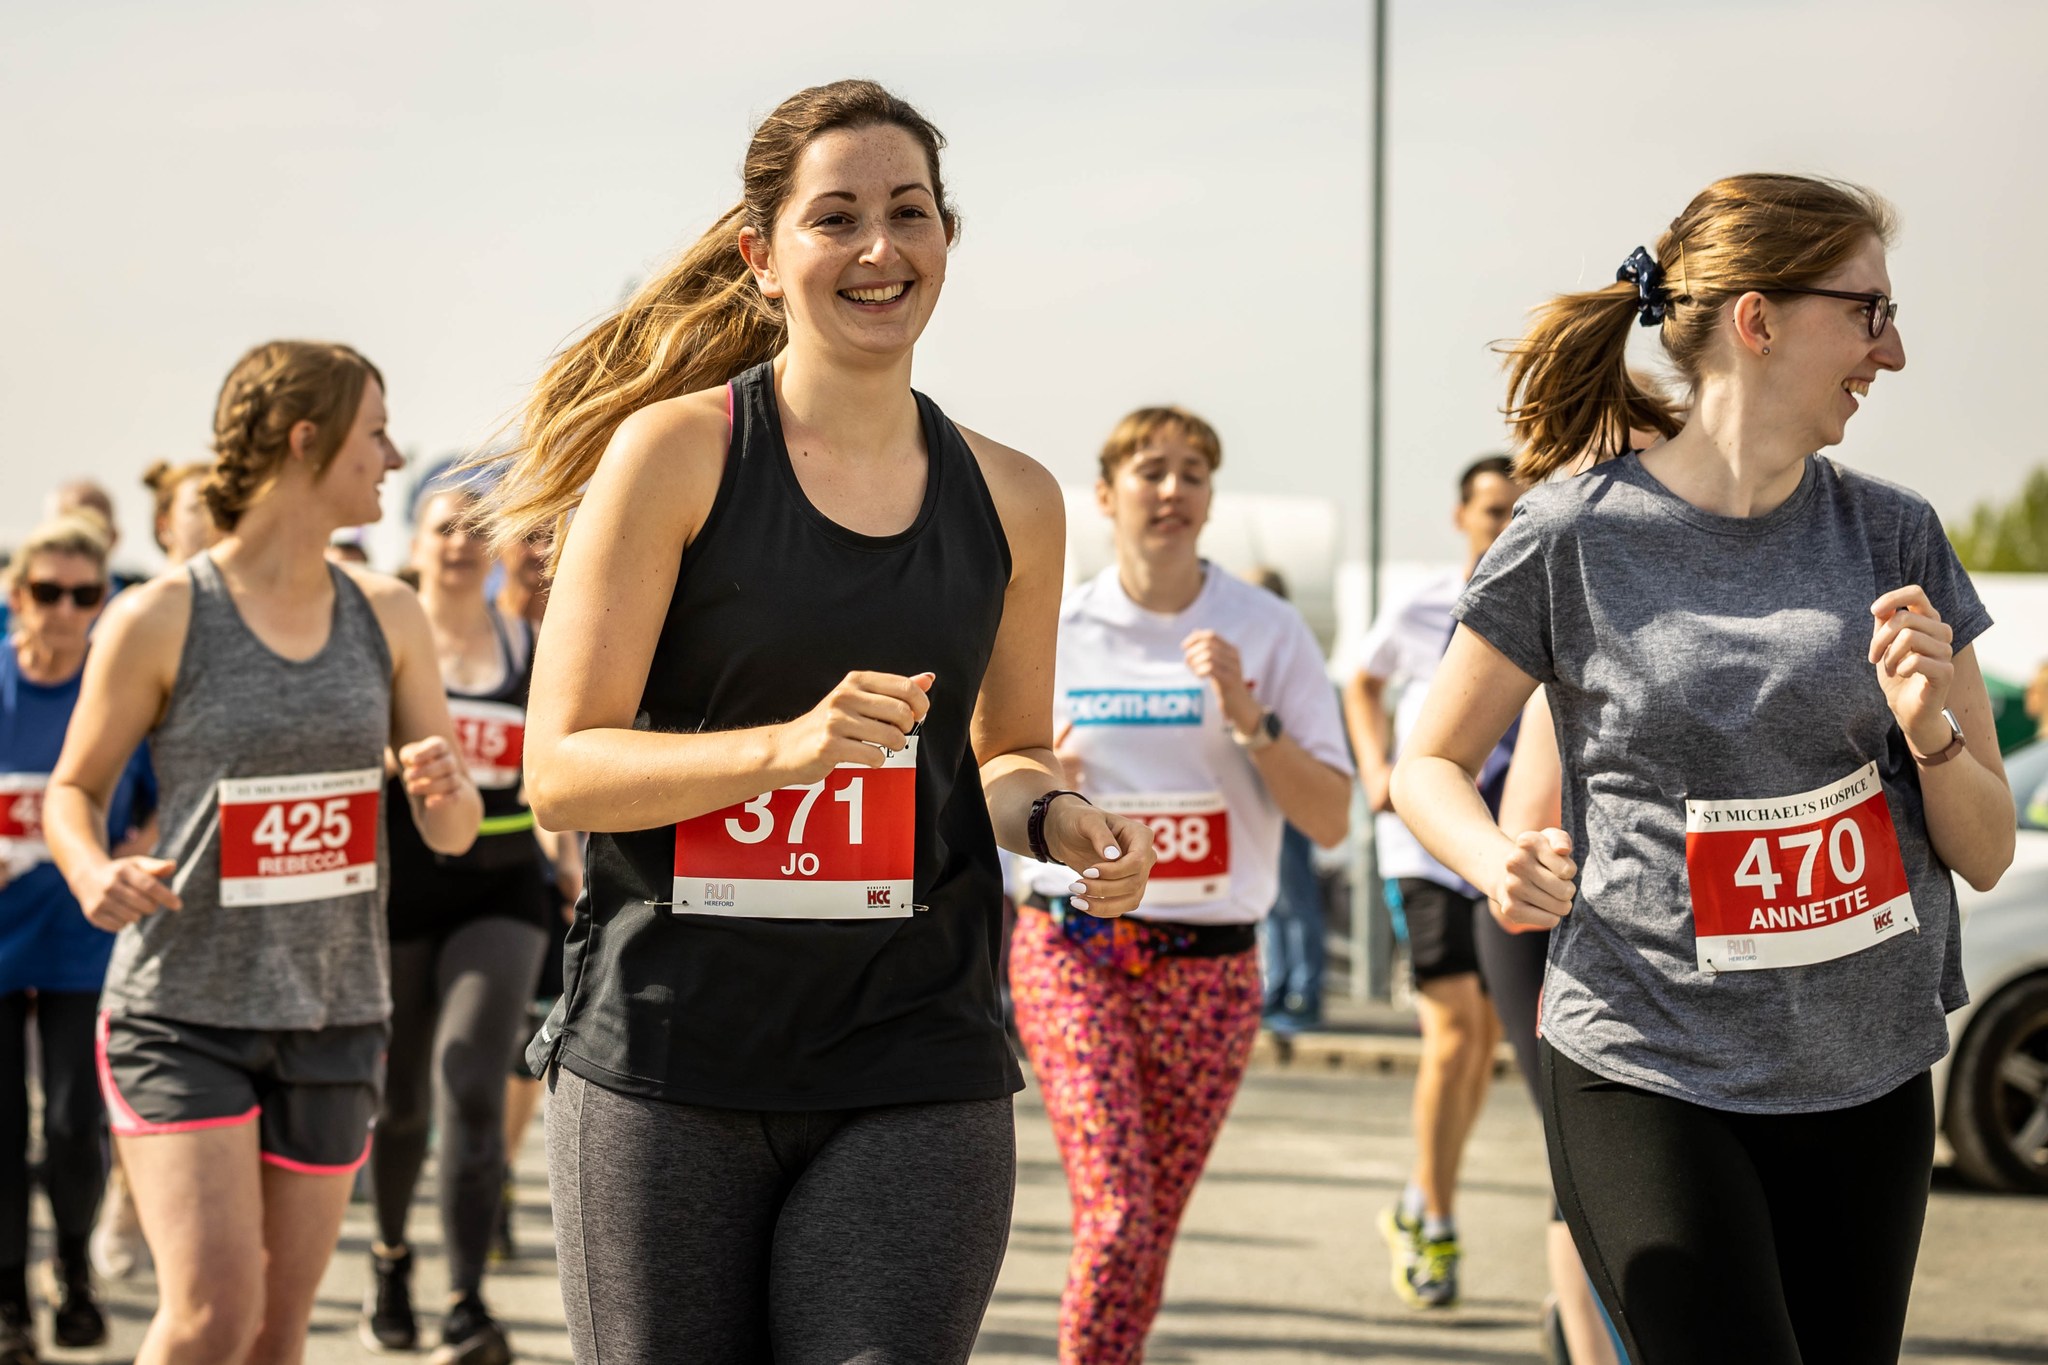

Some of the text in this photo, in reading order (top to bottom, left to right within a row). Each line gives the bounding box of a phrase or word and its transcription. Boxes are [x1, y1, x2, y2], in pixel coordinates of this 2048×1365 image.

[724, 777, 863, 845] 371
[1703, 811, 1721, 823] ST
[1820, 778, 1868, 810] HOSPICE
[252, 798, 352, 853] 425
[1138, 817, 1211, 863] 38
[257, 849, 348, 876] REBECCA
[781, 852, 820, 876] JO
[1734, 817, 1866, 900] 470
[704, 883, 735, 900] RUN
[867, 890, 890, 904] HCC
[1750, 885, 1869, 930] ANNETTE
[1873, 910, 1893, 931] HCC
[1727, 938, 1756, 955] RUN
